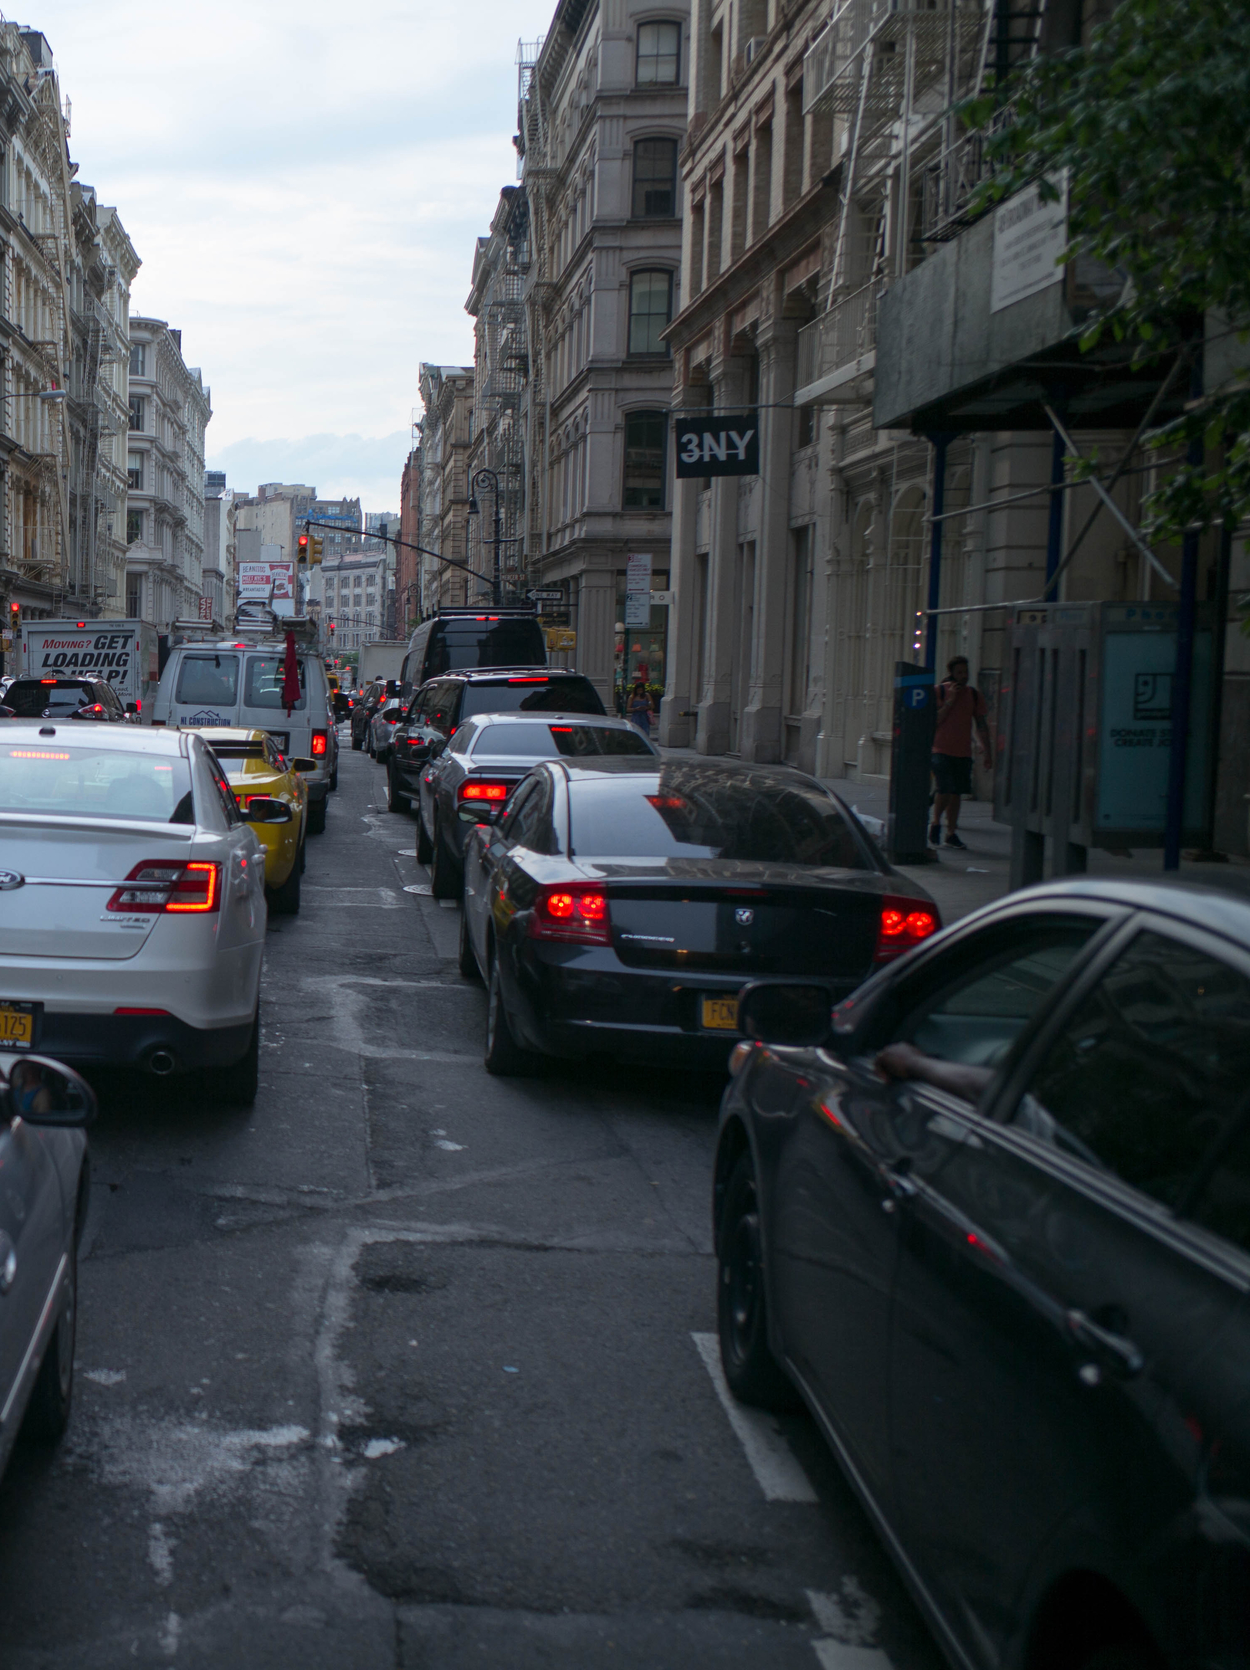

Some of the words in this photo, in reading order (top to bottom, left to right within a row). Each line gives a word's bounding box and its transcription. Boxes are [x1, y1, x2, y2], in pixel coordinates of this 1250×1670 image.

[680, 429, 756, 464] 3NY
[93, 634, 134, 650] GET
[41, 652, 131, 668] LOADING
[912, 688, 926, 707] P
[188, 716, 232, 727] CONSTRUCTION
